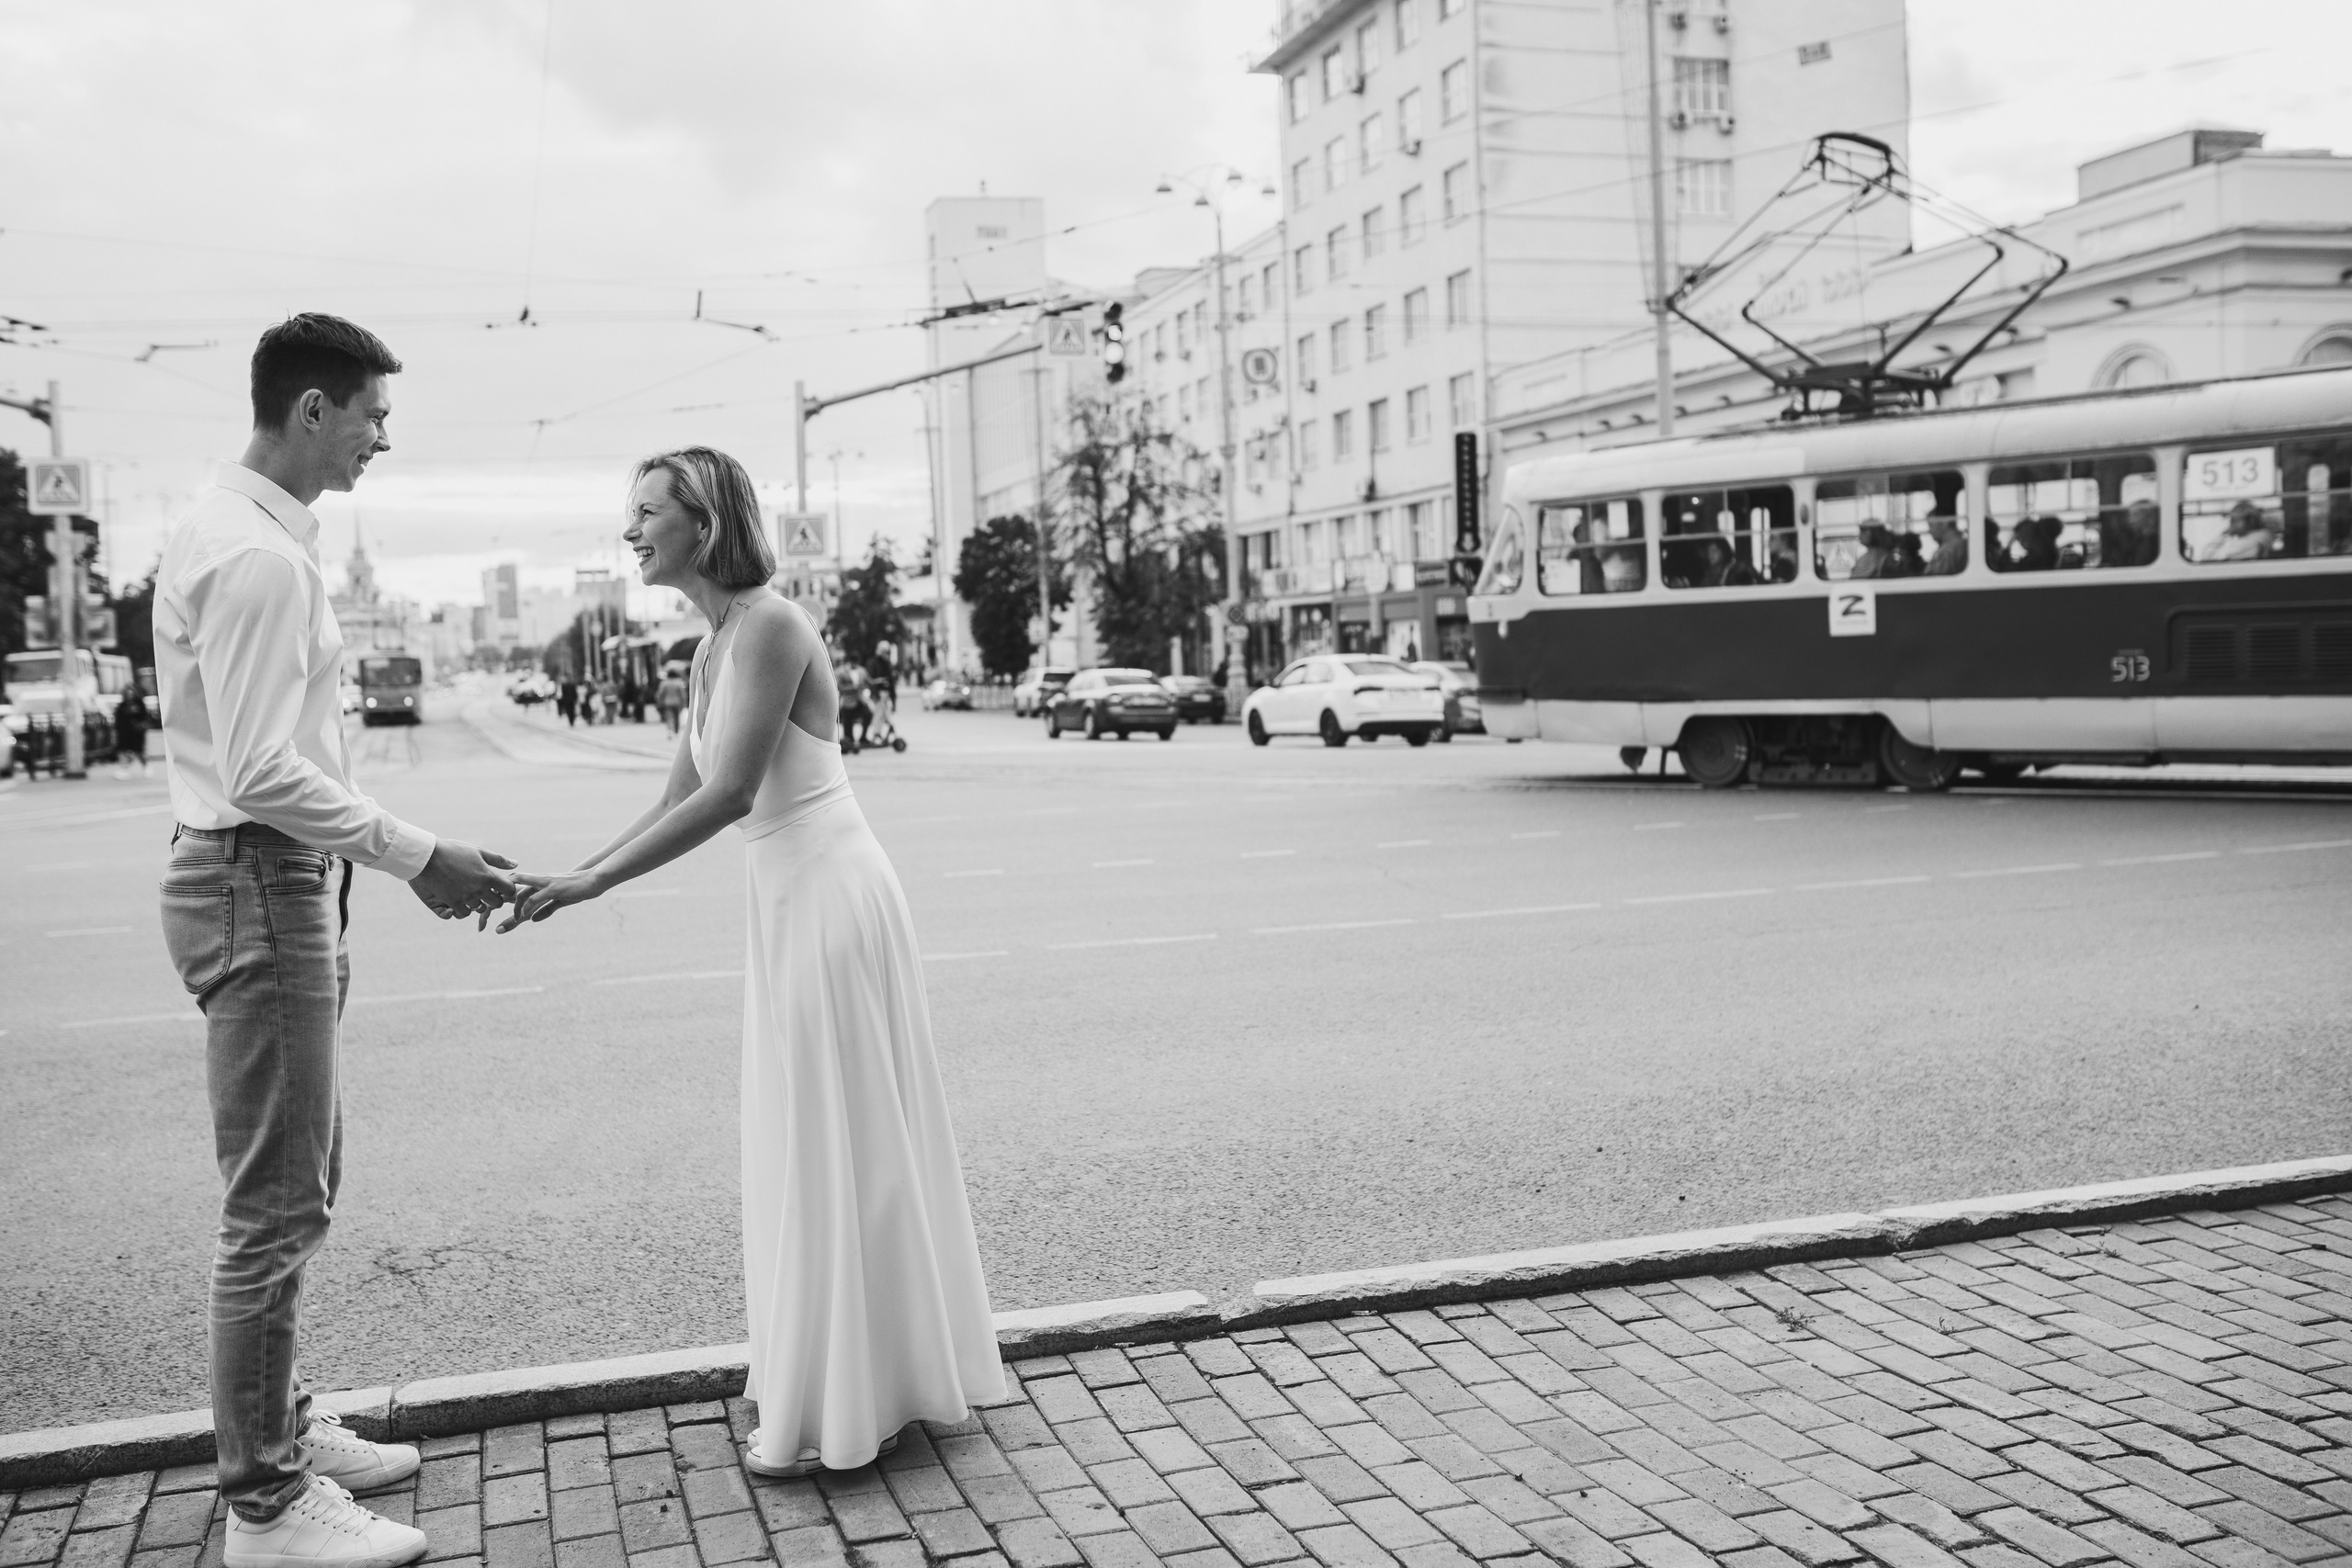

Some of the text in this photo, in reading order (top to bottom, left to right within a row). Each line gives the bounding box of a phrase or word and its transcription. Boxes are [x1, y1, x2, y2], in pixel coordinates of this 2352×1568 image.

[2202, 457, 2258, 486] 513
[1838, 594, 1867, 616] Z
[2110, 655, 2151, 682] 513
